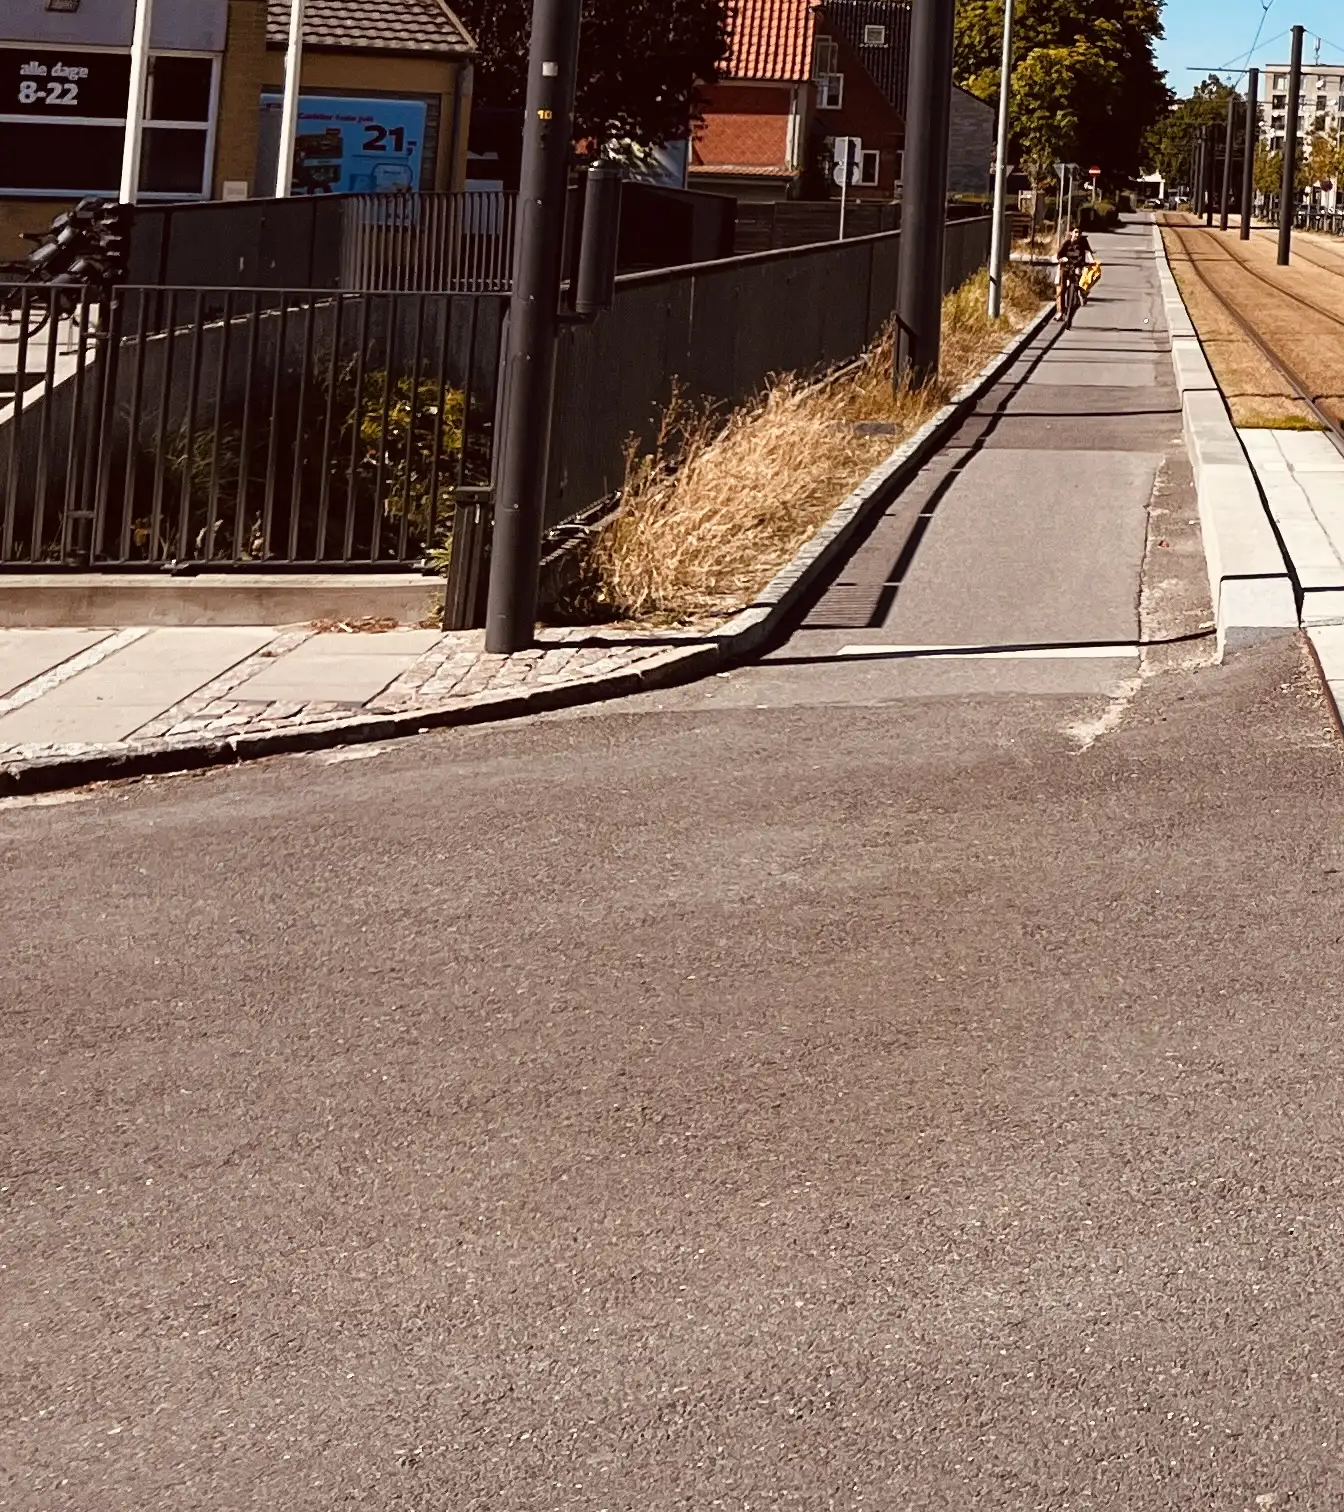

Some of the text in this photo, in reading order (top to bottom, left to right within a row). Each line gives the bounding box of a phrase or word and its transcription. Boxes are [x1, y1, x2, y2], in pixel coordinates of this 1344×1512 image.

[20, 61, 88, 80] alle dage
[18, 81, 78, 105] 8-22
